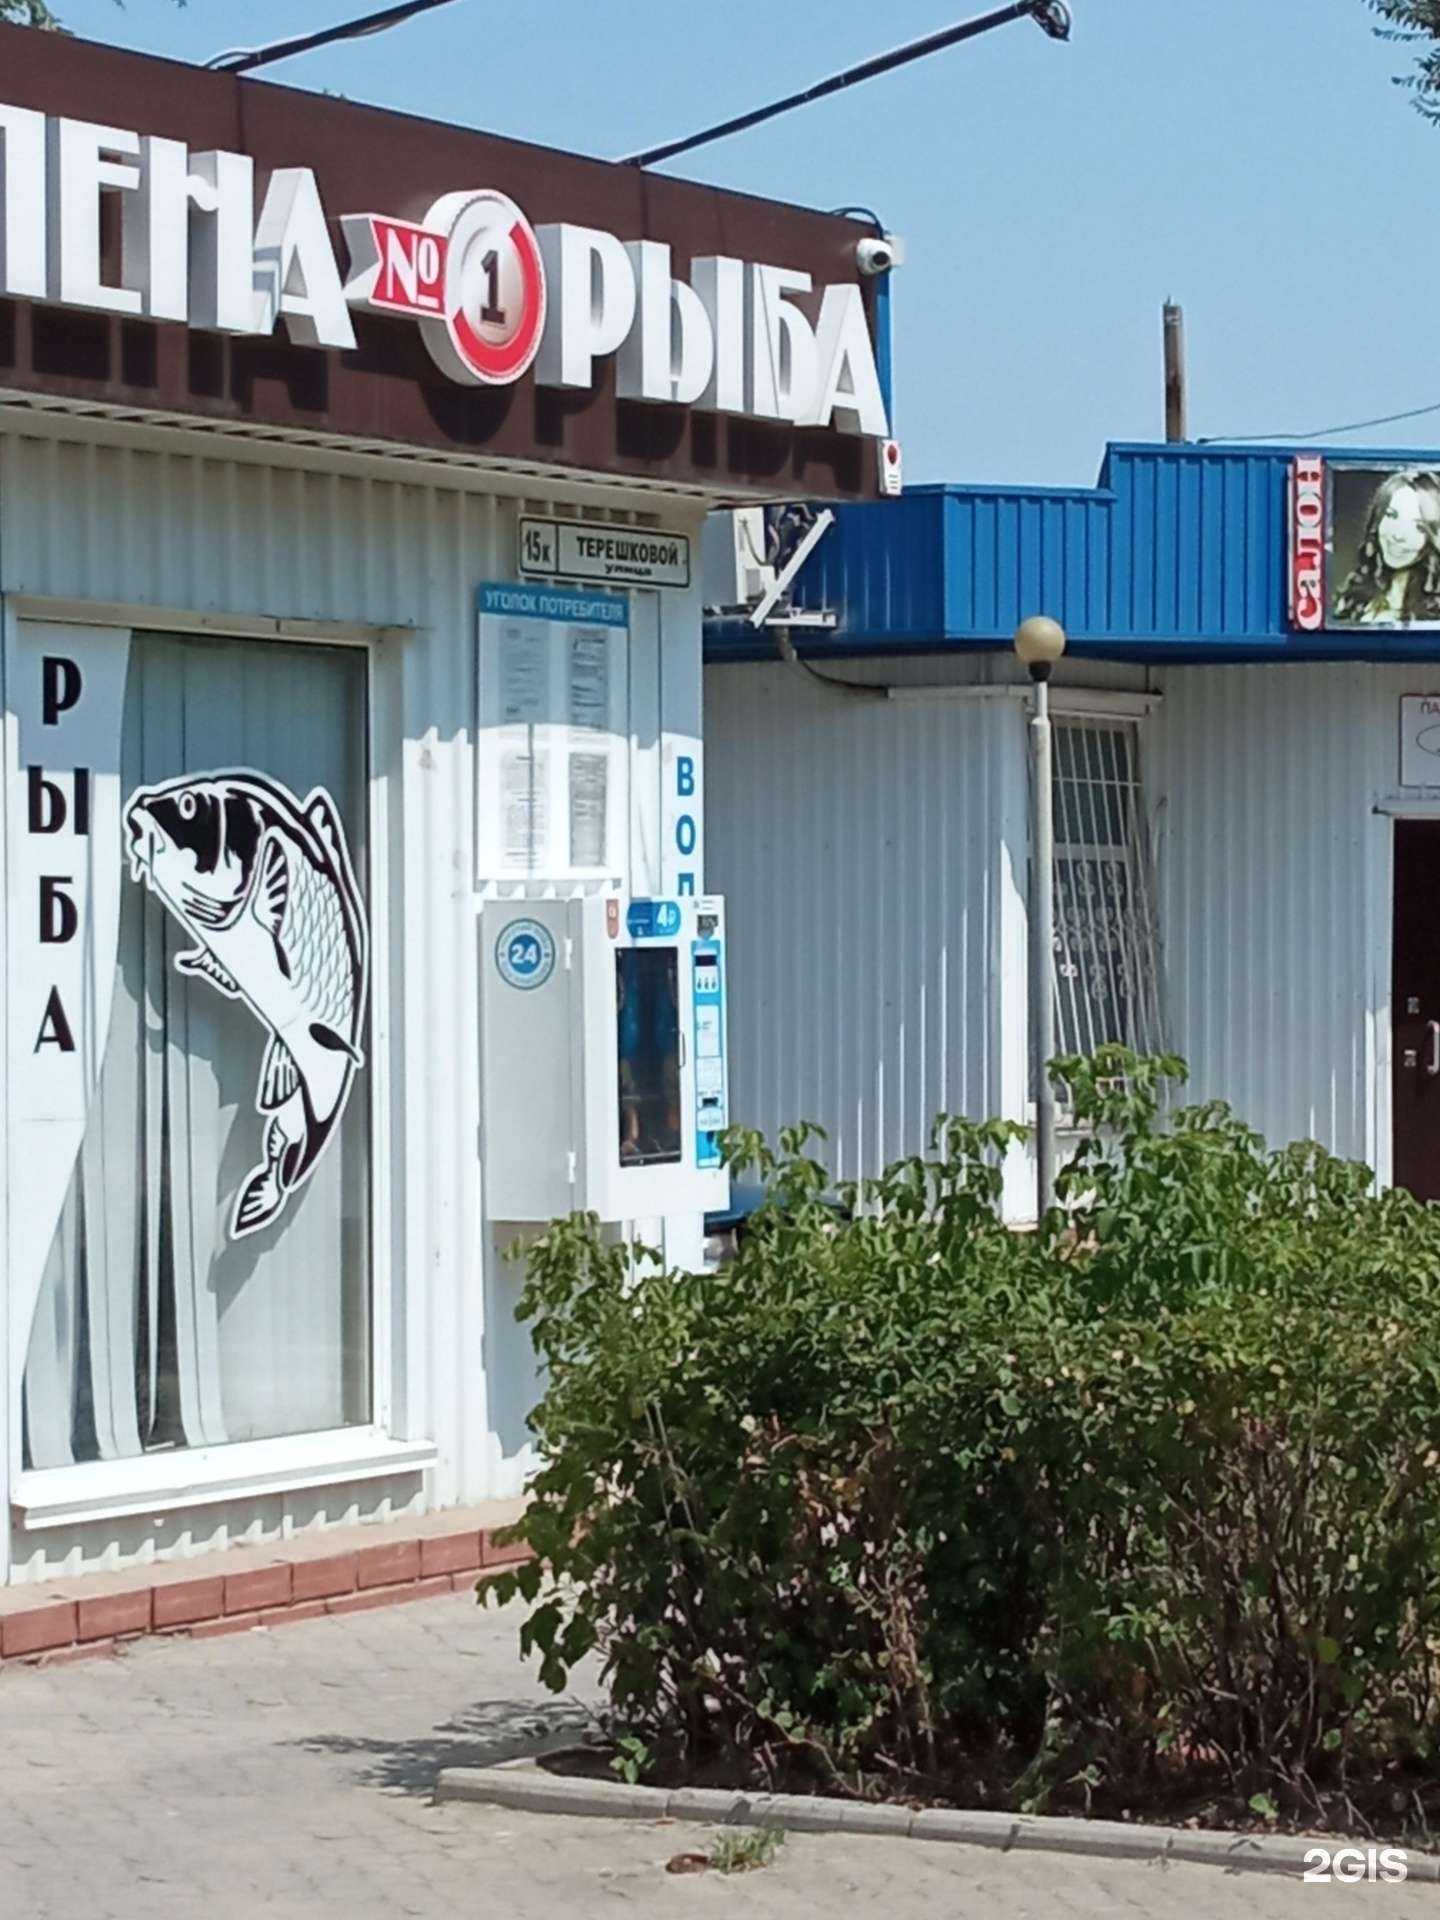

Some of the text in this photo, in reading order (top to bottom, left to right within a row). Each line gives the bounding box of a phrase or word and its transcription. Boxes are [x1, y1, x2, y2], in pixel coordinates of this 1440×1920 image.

[538, 223, 889, 437] РЫБА
[576, 535, 679, 566] ТЕРЕШКОВОЙ
[604, 563, 653, 576] улица
[485, 590, 625, 622] УГОЛОК ПОТРЕБИТЕЛЯ
[28, 656, 90, 1054] РЫБА
